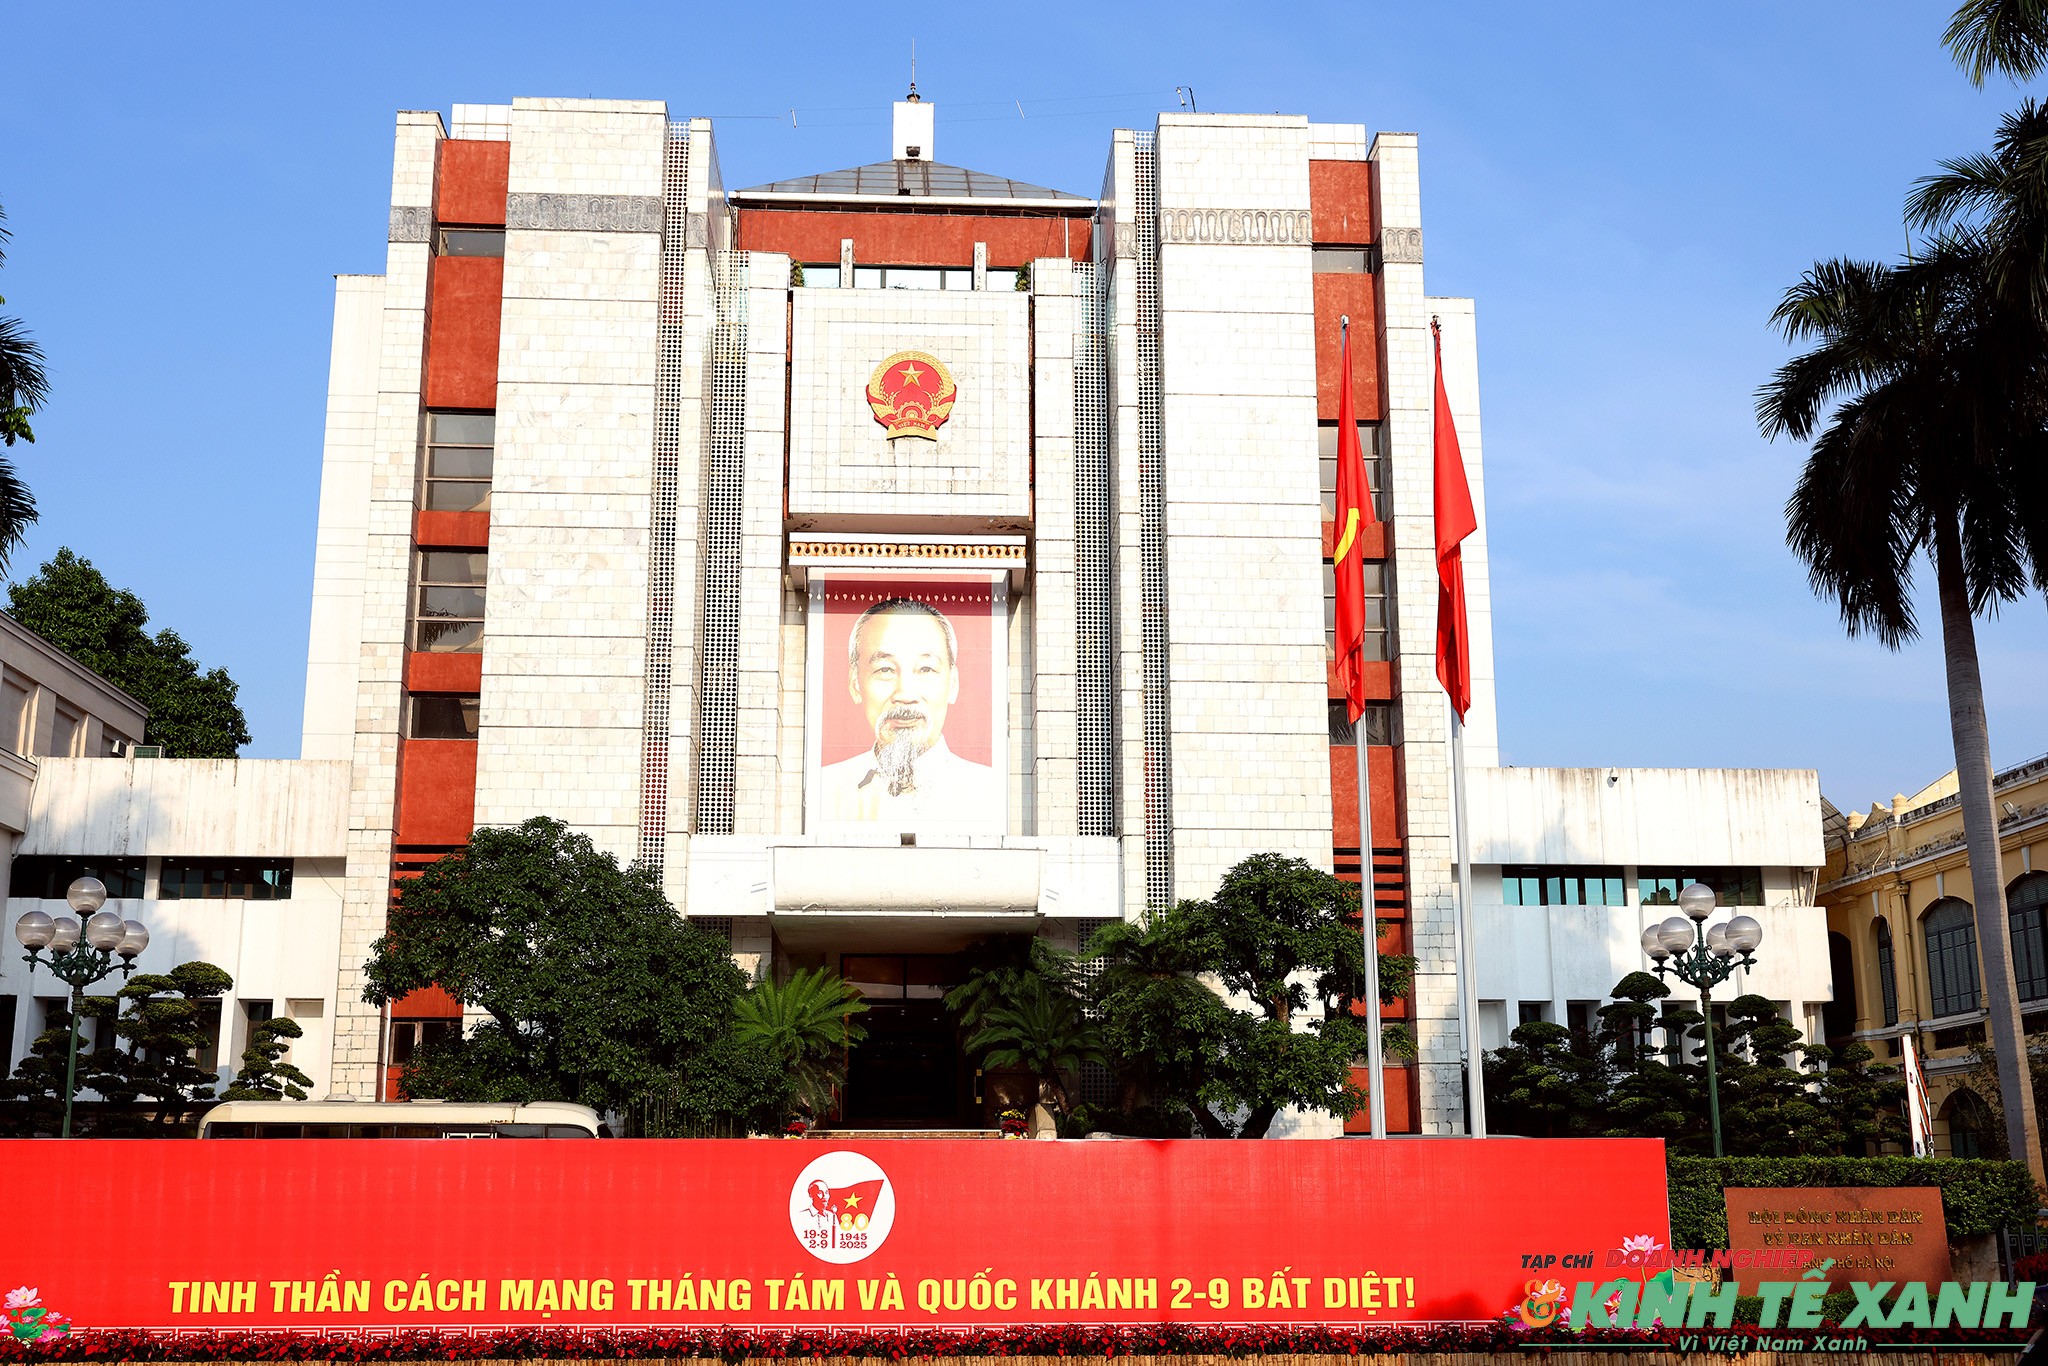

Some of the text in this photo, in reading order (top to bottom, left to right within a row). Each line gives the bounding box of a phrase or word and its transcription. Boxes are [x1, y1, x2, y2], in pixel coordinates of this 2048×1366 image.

[839, 1213, 869, 1231] 80
[1748, 1208, 1781, 1227] HỘI
[1835, 1208, 1885, 1224] NHÂN
[1887, 1208, 1923, 1224] DÂN
[840, 1233, 868, 1241] 1945
[840, 1241, 868, 1249] 2025
[1788, 1231, 1823, 1246] BAN
[1826, 1229, 1875, 1246] NHÂN
[1877, 1229, 1914, 1246] DÂN
[1856, 1255, 1873, 1268] HÀ
[1875, 1255, 1896, 1271] NỘI
[169, 1266, 1415, 1318] TINH THẦN CÁCH MẠNG THÁNG TÁM VÀ QUỐC KHÁNH 2-9 BẤT DIỆT!
